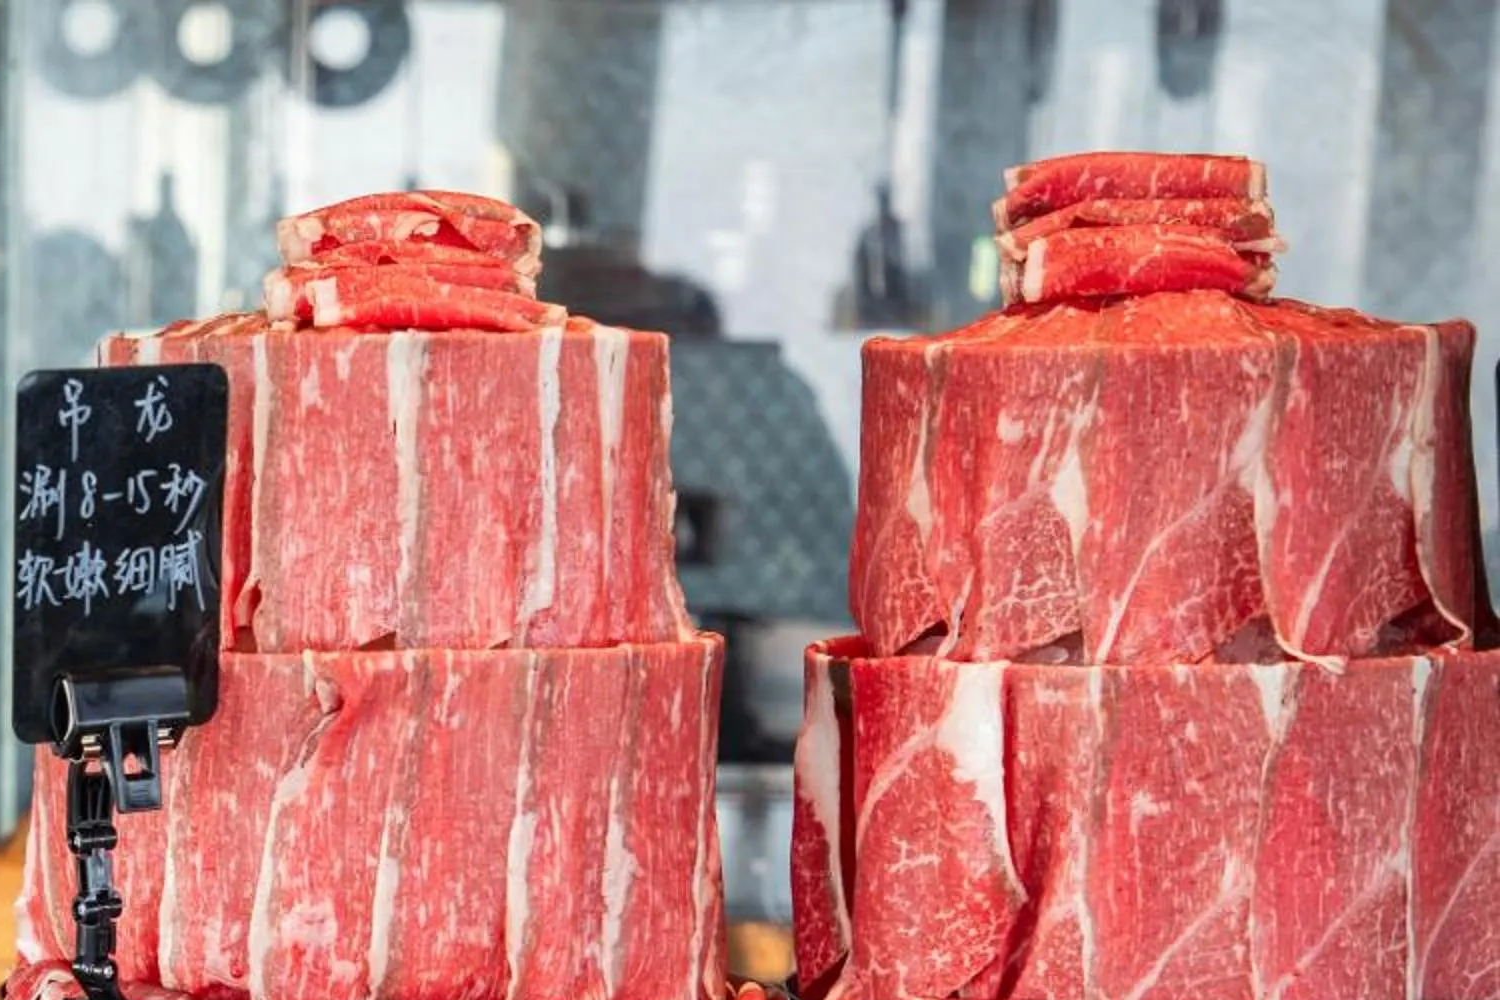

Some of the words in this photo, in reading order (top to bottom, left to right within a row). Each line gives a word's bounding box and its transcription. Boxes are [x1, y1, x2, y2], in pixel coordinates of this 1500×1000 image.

[58, 375, 173, 462] 吊龙
[16, 531, 206, 617] 软嫩细腻
